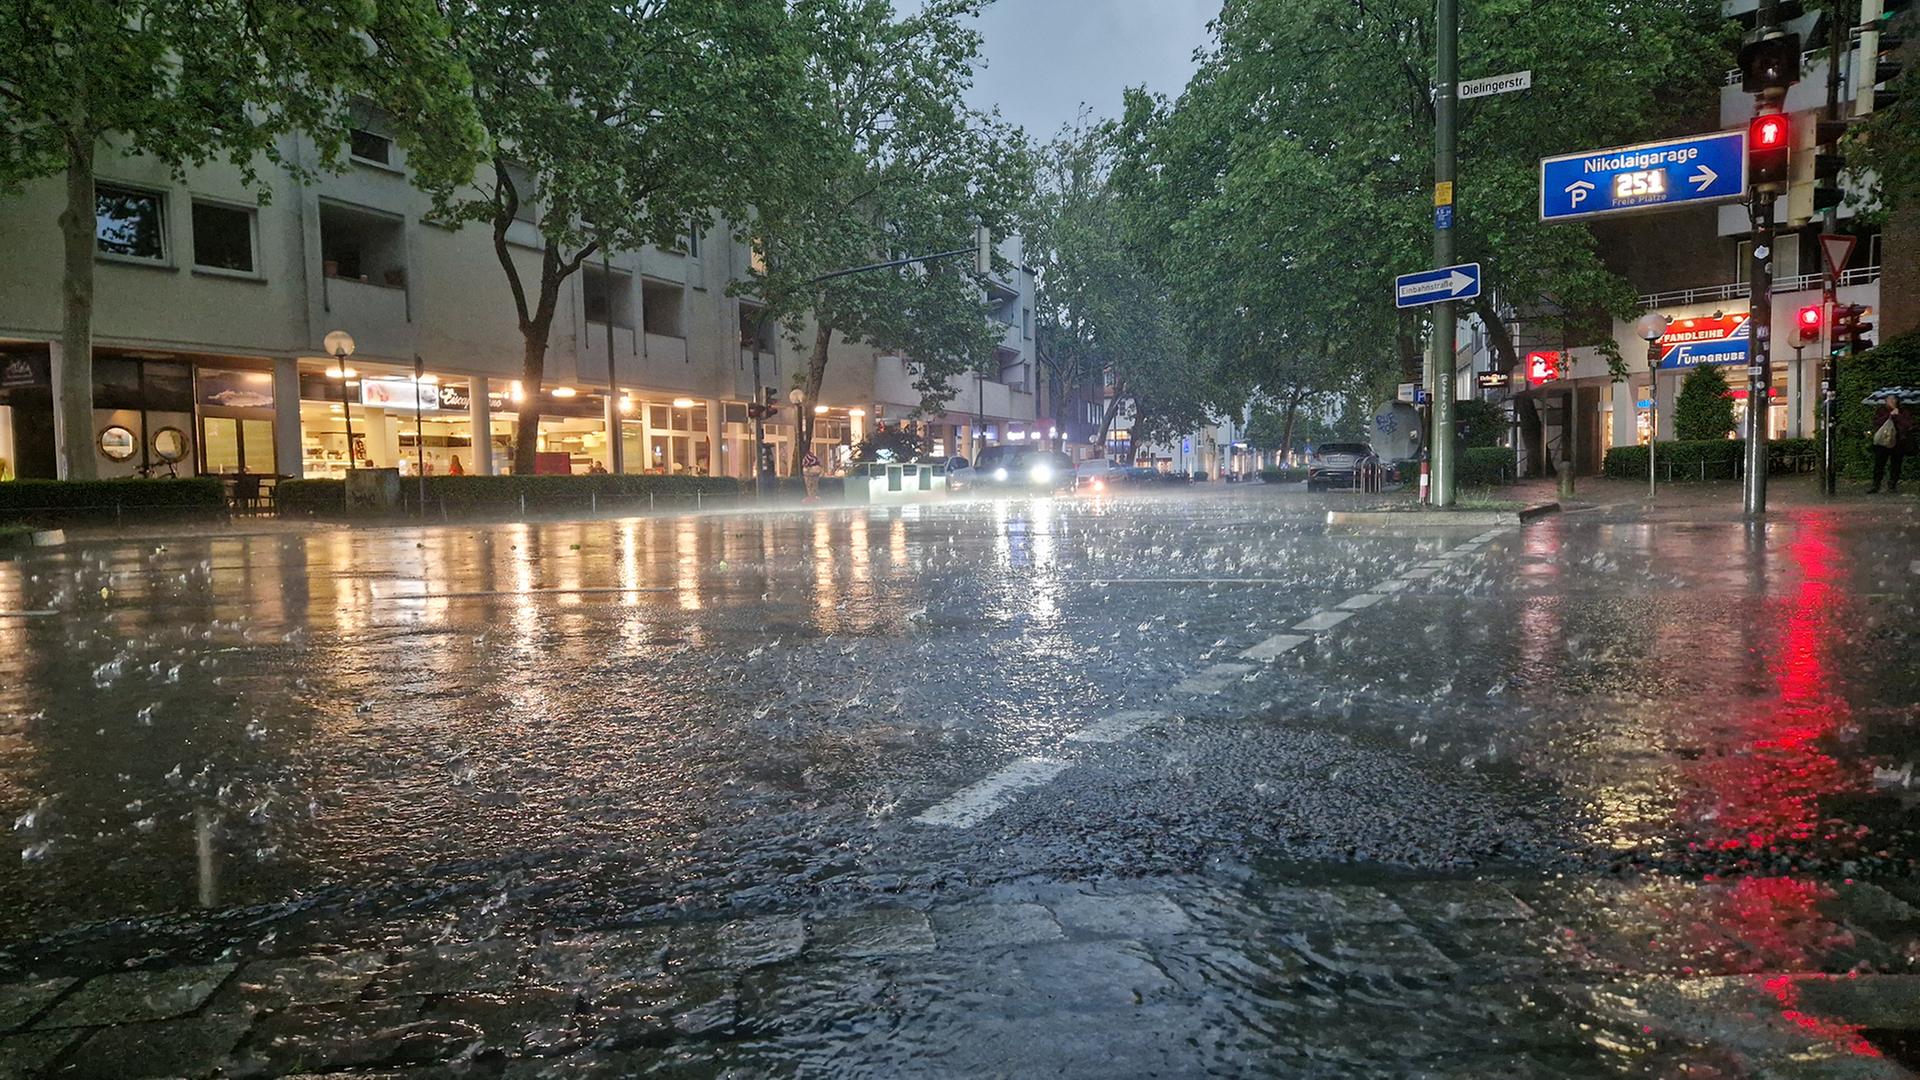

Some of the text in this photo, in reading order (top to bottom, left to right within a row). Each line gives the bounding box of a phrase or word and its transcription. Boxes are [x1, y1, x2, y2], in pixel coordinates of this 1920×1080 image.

[1462, 77, 1526, 96] Dielingerstr.
[1584, 147, 1698, 174] Nikolaigarage
[1616, 170, 1665, 197] 251
[1571, 189, 1587, 209] P
[1612, 197, 1635, 207] Freie
[1401, 280, 1454, 296] Einbahnstraße
[1655, 329, 1724, 344] FANDLEIHE
[1677, 346, 1746, 365] FUNDGRUBE
